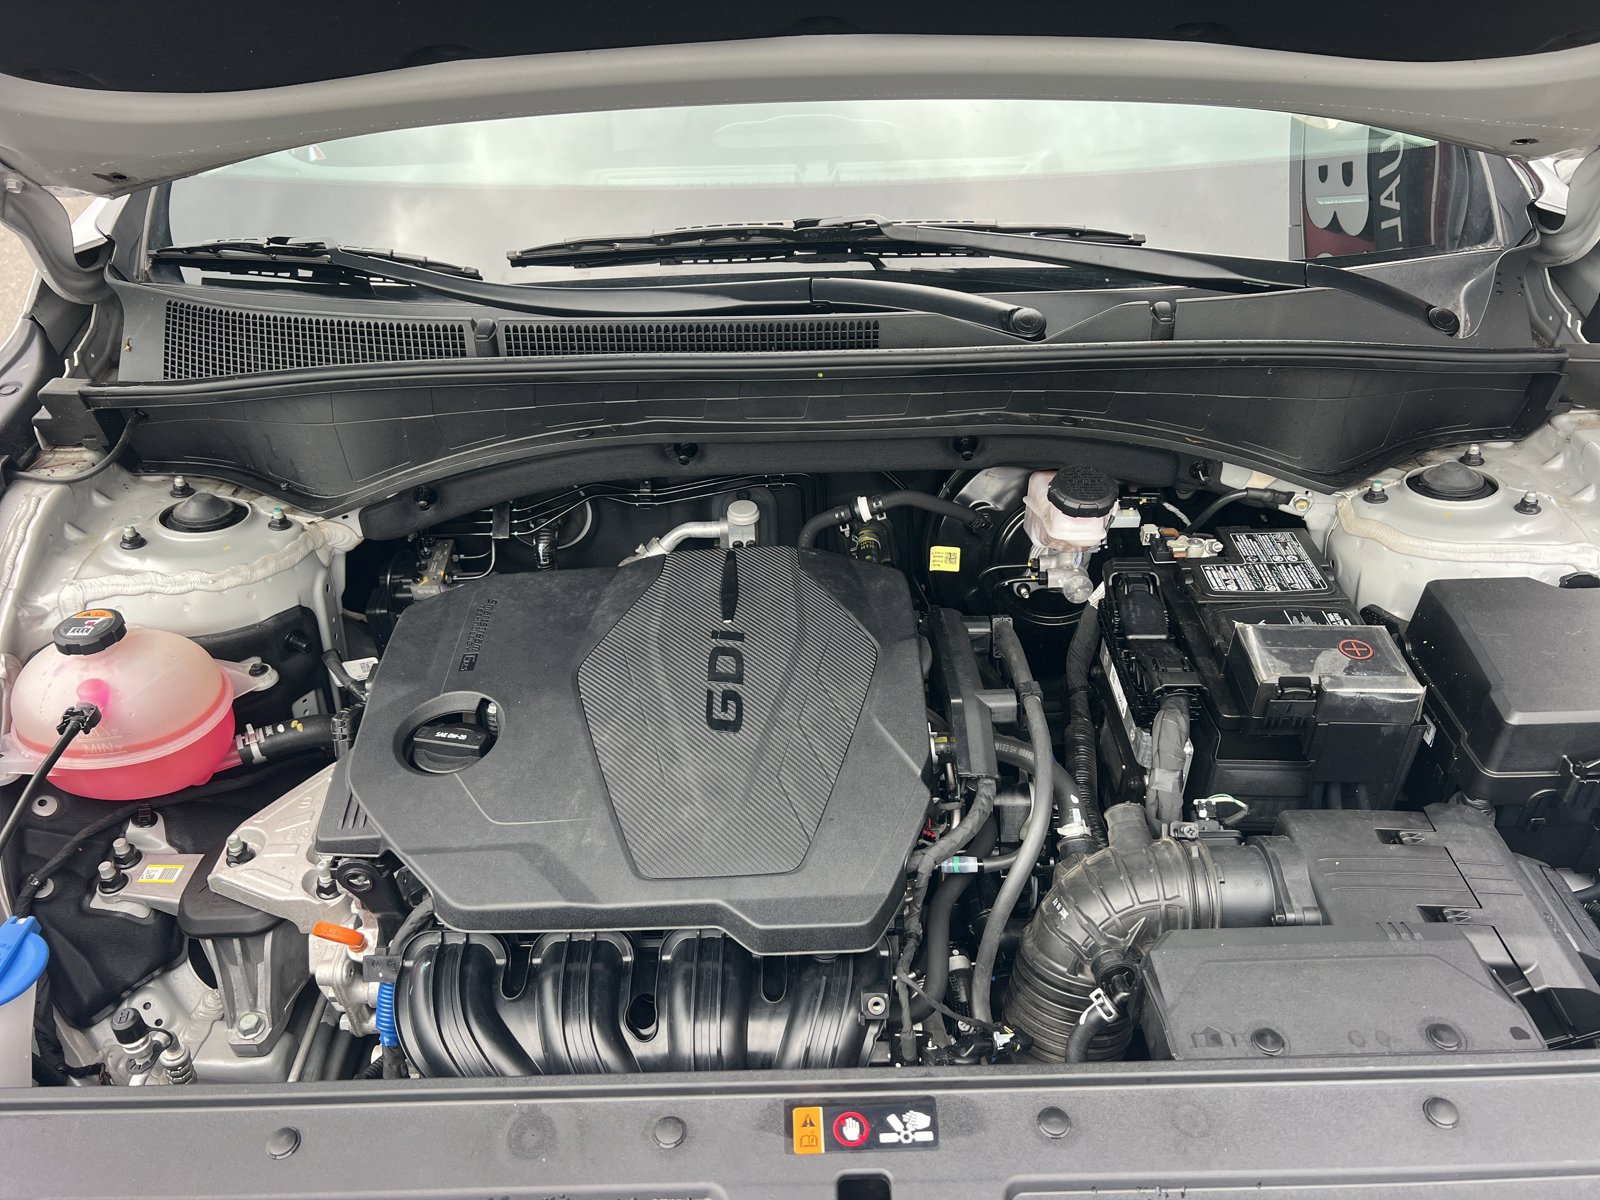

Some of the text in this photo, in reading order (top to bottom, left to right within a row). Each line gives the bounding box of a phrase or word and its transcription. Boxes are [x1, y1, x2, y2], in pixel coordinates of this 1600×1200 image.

[471, 598, 498, 652] Smartstream
[706, 629, 745, 734] GDi
[81, 742, 114, 754] MIN
